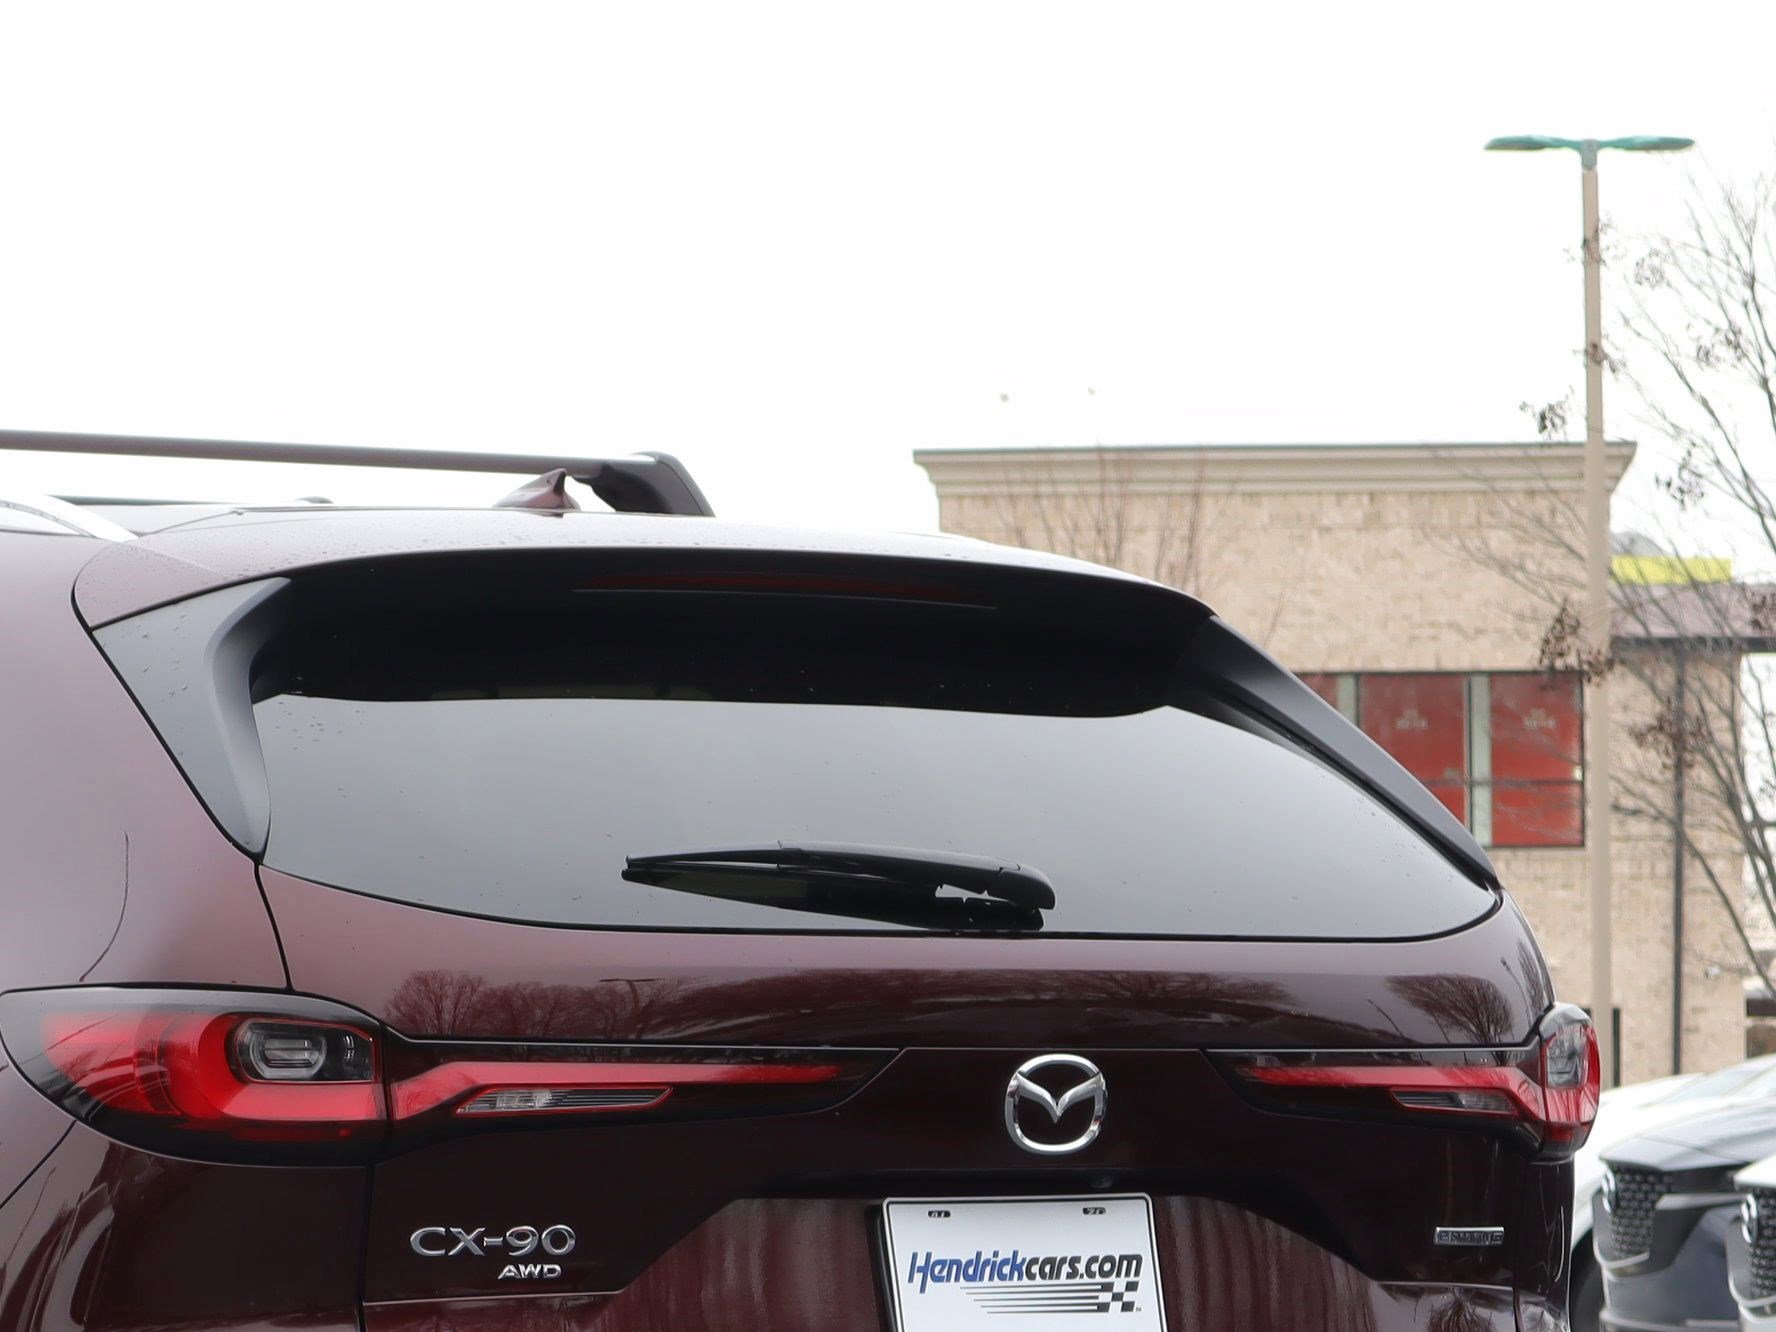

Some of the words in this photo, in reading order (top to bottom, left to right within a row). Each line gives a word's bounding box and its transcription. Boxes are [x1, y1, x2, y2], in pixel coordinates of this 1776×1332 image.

[410, 1225, 576, 1256] CX-90
[498, 1263, 562, 1279] AWD
[908, 1250, 1143, 1294] Hendrickcars.com
